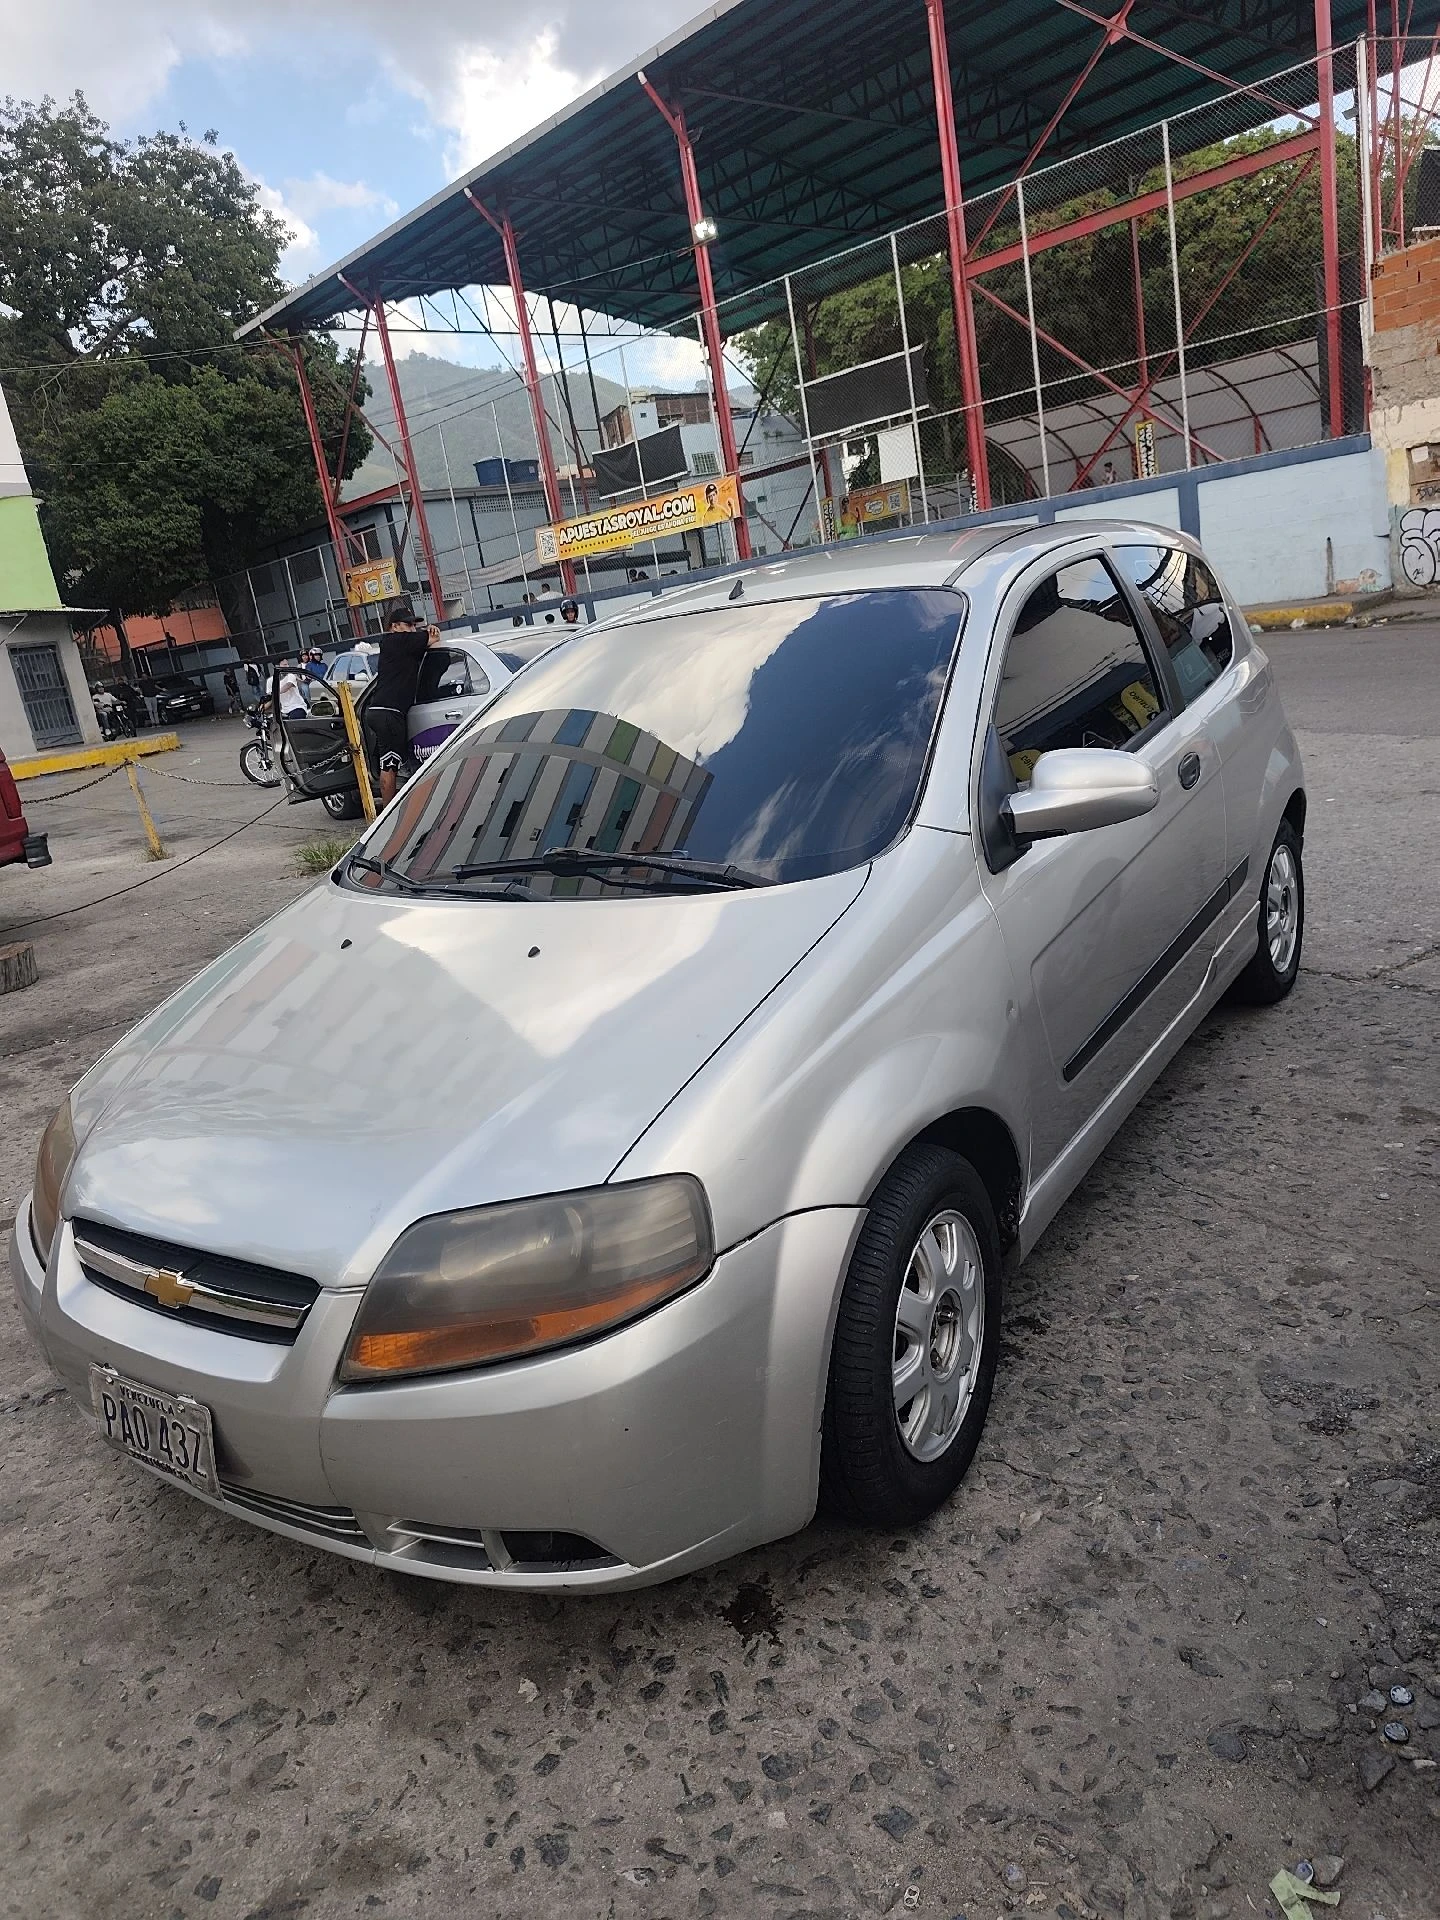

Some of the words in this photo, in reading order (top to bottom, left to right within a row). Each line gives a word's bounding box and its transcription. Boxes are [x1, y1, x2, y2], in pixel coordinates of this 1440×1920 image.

[559, 495, 696, 545] APUESTASROYAL.COM
[119, 1384, 175, 1416] VENEZUELA
[159, 1415, 207, 1479] 43Z
